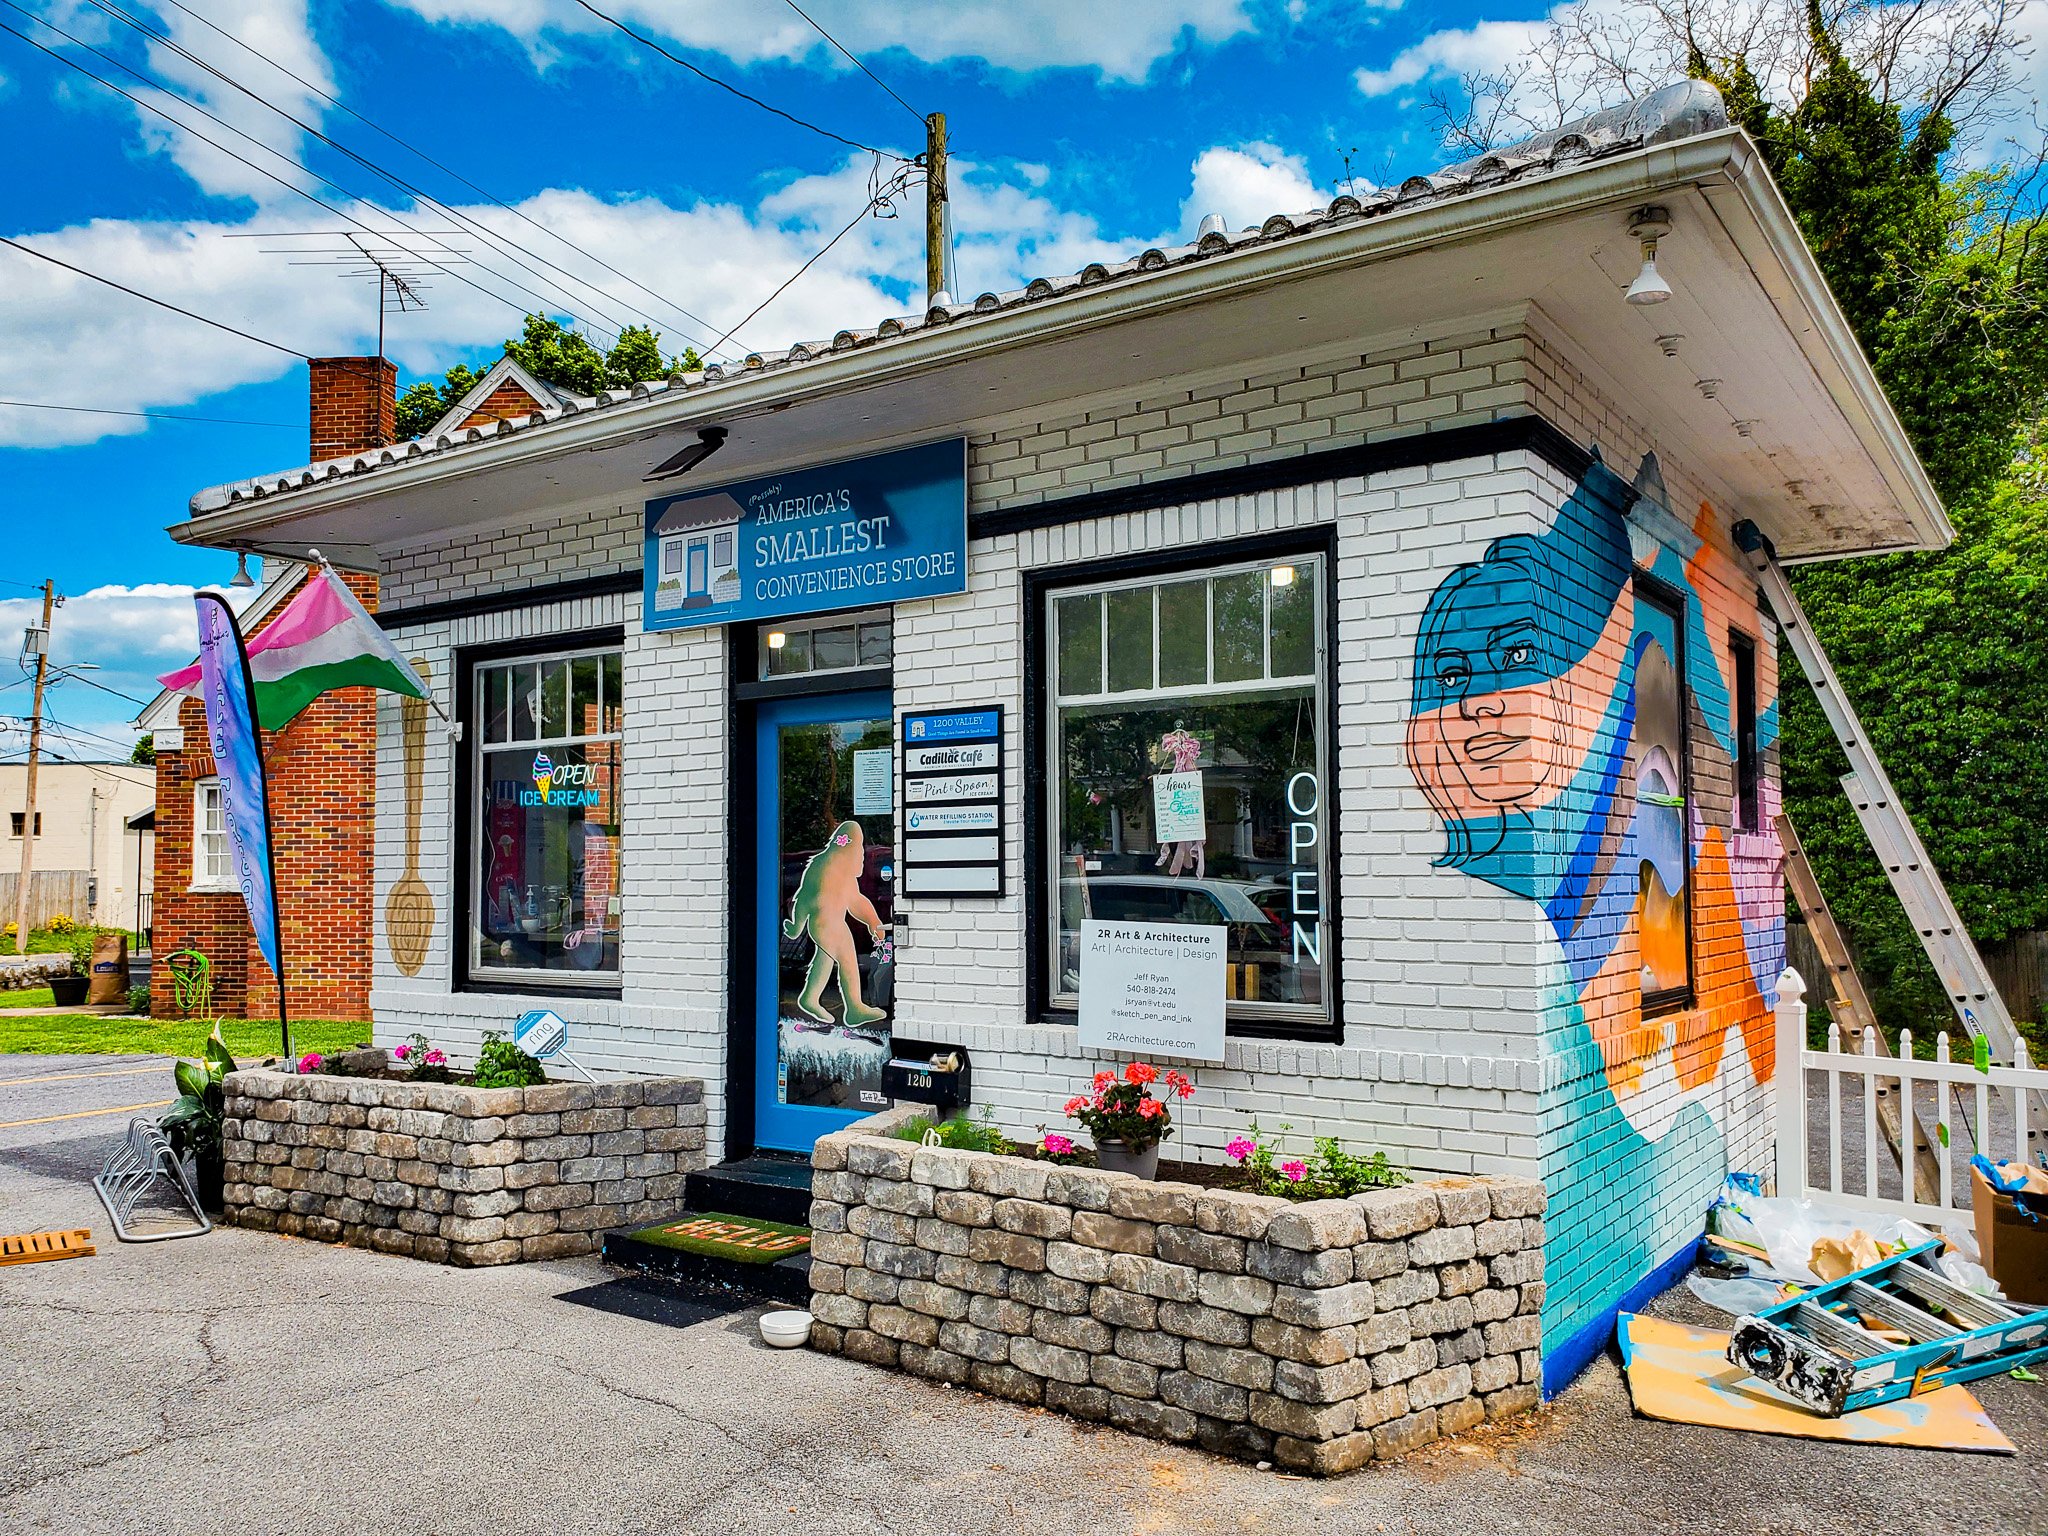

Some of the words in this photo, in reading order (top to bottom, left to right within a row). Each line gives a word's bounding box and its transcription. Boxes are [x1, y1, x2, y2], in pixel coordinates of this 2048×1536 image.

[755, 489, 850, 526] AMERICA'S
[755, 516, 890, 568] SMALLEST
[755, 562, 887, 601] CONVENIENCE
[892, 552, 956, 582] STORE
[933, 719, 953, 728] 1200
[954, 716, 984, 726] VALLEY
[920, 751, 959, 765] Cadillac
[961, 749, 983, 766] Café
[552, 762, 598, 786] OPEN
[924, 782, 948, 798] Pint
[954, 778, 988, 795] Spoon
[1166, 776, 1191, 792] hours
[520, 790, 543, 807] ICE
[547, 789, 599, 807] CREAM
[1287, 772, 1321, 966] OPEN
[1097, 929, 1111, 938] 2R
[1114, 930, 1130, 940] Art
[1133, 931, 1141, 940] &
[1144, 931, 1211, 944] Architecture
[1091, 942, 1106, 953] Art
[1114, 943, 1174, 957] Architecture
[1183, 948, 1218, 961] Design
[1134, 973, 1148, 981] Jeff
[1150, 974, 1170, 984] Ryan
[1126, 984, 1176, 996] 540-818-2474
[1125, 998, 1176, 1009] jsryan@vt.edu
[1111, 1008, 1192, 1024] @sketch_pen_and_ink
[529, 1022, 555, 1045] ring
[1106, 1031, 1196, 1049] 2RArchitecture.com
[907, 1073, 932, 1088] 1200
